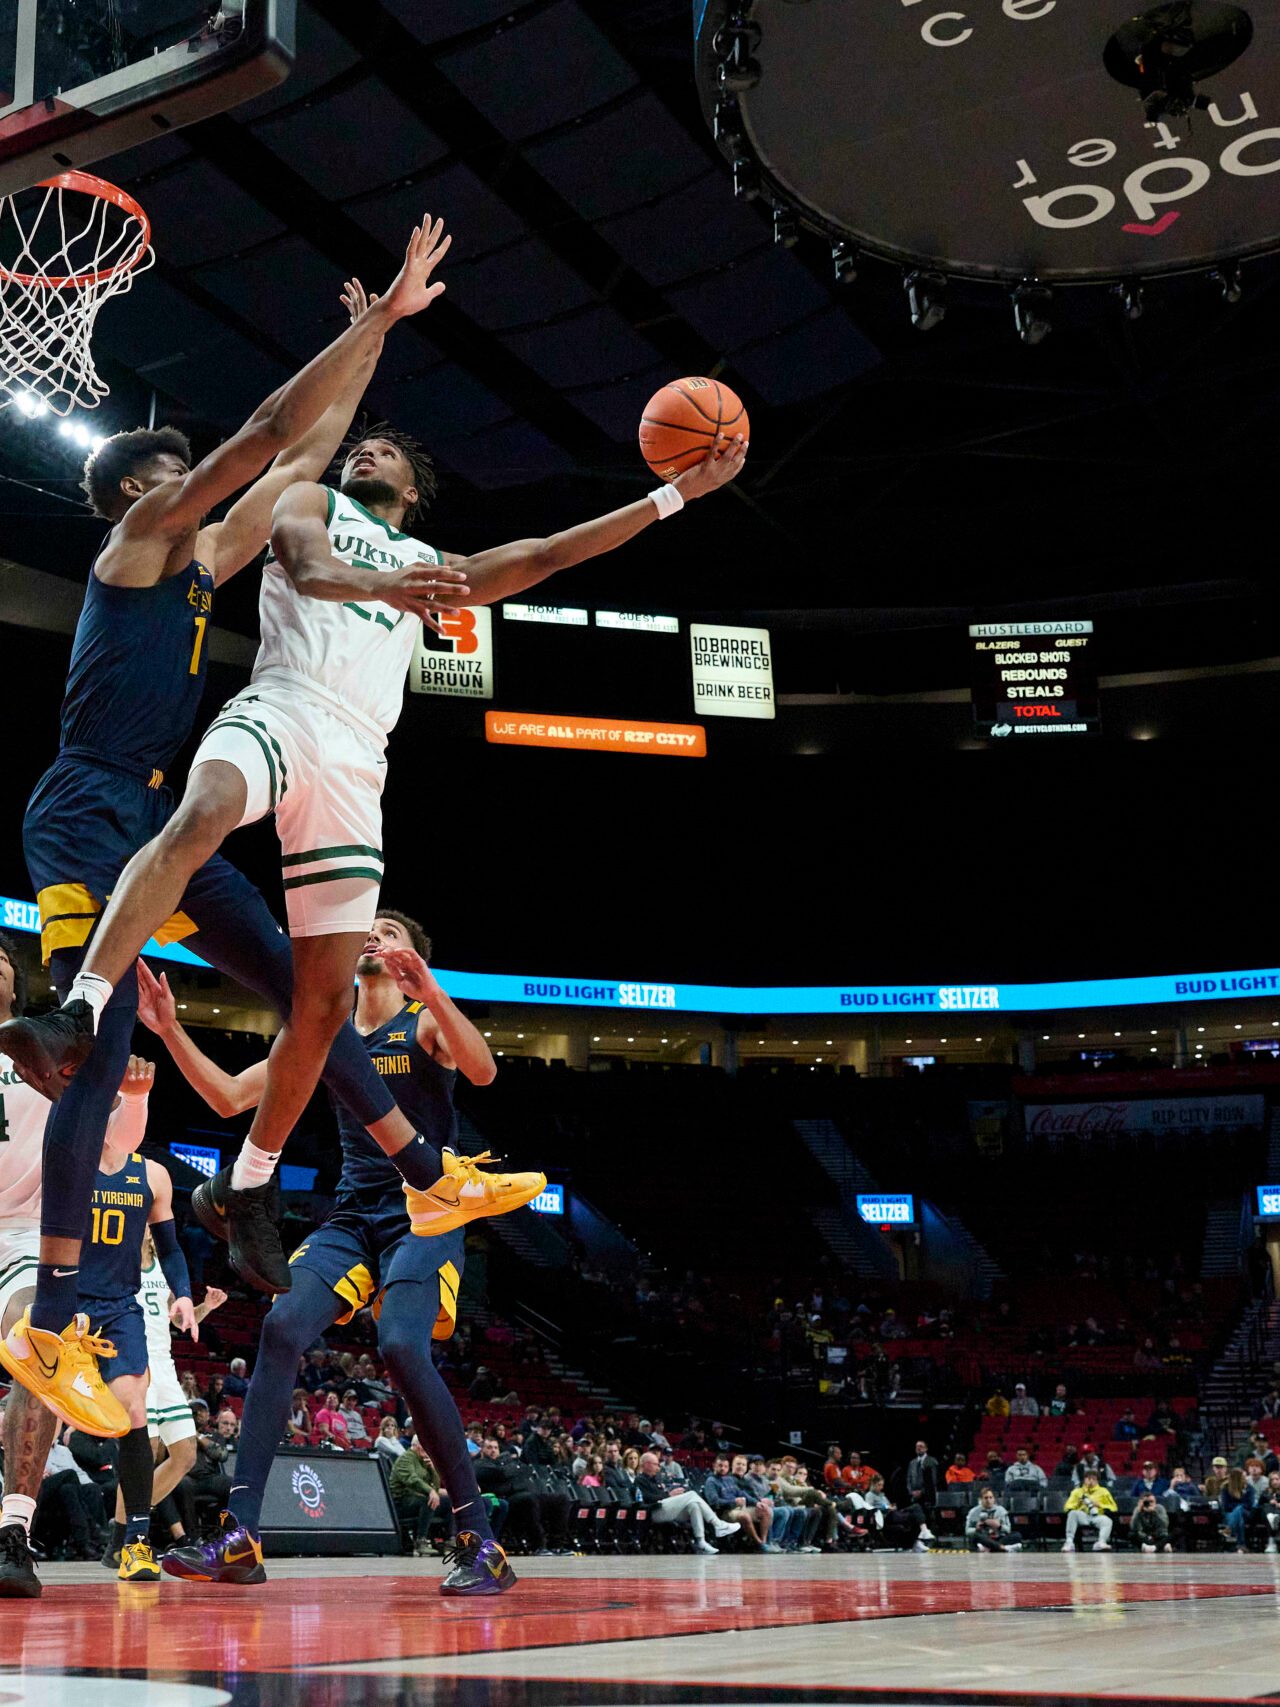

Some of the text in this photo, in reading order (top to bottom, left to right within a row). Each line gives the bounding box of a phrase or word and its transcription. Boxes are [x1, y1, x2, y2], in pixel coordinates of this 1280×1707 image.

[332, 534, 405, 570] VIKIN
[527, 604, 563, 616] HOME
[618, 612, 657, 623] GUEST
[977, 622, 1085, 636] HUSTLEBOARD
[189, 616, 207, 675] 1
[693, 636, 769, 657] 10 BARREL
[975, 638, 1088, 650] BLAZERS GUEST
[421, 656, 483, 673] LORENTZ
[694, 652, 753, 670] BREWING
[995, 651, 1071, 664] BLOCKED SHOTS
[421, 670, 484, 689] BRUUN
[1001, 668, 1068, 682] REBOUNDS
[421, 685, 485, 696] CONSTRUCTION
[696, 682, 772, 701] DRINK BEER
[1006, 685, 1065, 698] STEALS
[1013, 705, 1062, 718] TOTAL
[493, 722, 697, 746] WE ARE ALL PART OF RIP CITY
[3, 900, 42, 931] SELTZ
[1175, 975, 1279, 996] BUD LIGHT
[523, 983, 676, 1008] BUD LIGHT SELTZER
[840, 987, 1000, 1010] BUD LIGHT SELTZER
[1152, 1110, 1176, 1125] RIP
[1179, 1108, 1210, 1123] CITY
[1214, 1106, 1245, 1122] ROW
[101, 1190, 144, 1208] VIRGINIA
[860, 1203, 910, 1222] SELTZER
[91, 1207, 126, 1246] 10
[144, 1292, 161, 1316] 5
[299, 1464, 326, 1494] KNIGHT
